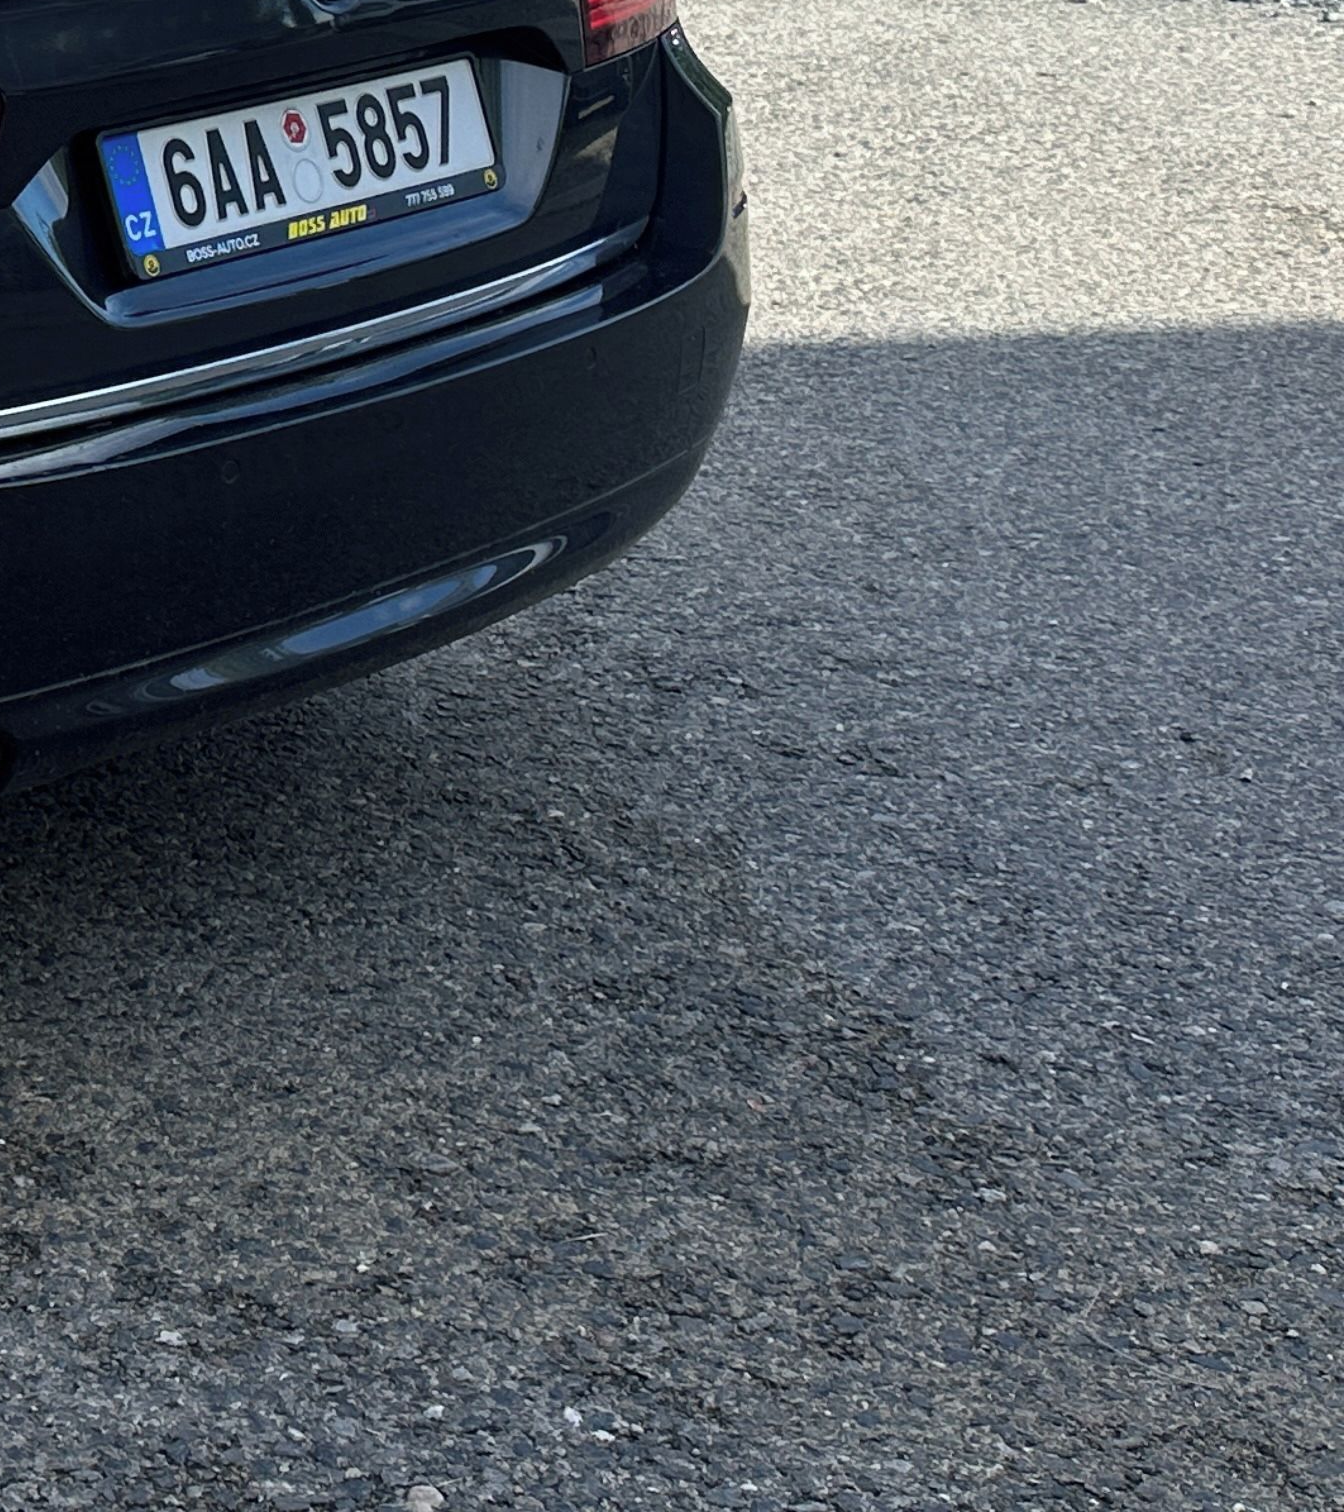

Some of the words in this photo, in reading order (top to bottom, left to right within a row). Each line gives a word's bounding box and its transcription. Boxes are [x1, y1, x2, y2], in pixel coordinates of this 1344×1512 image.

[162, 119, 287, 227] 6AA
[316, 75, 450, 188] 5857
[125, 208, 157, 241] CZ
[288, 215, 326, 240] BOSS
[328, 204, 368, 230] AUTO
